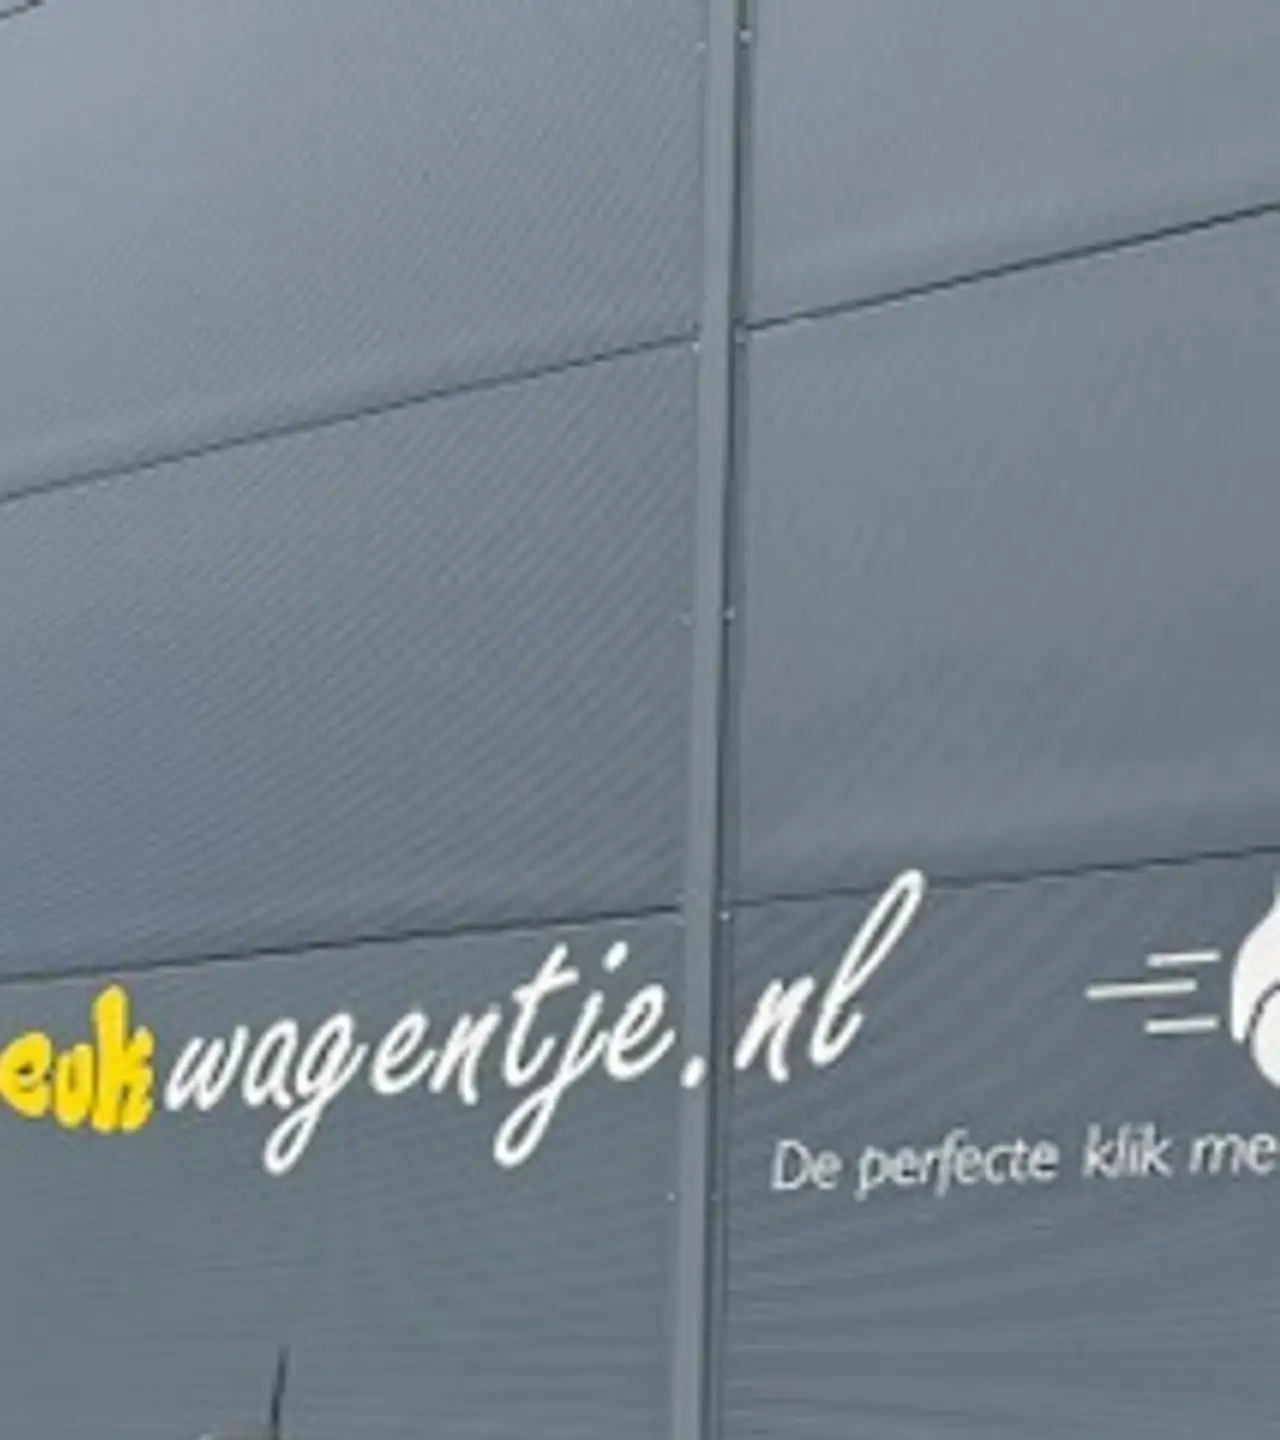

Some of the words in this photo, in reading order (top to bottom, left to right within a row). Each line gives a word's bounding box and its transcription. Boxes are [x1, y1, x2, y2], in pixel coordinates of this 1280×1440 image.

[770, 1138, 844, 1192] De
[854, 1127, 1061, 1201] perfecte
[1082, 1121, 1174, 1181] klik
